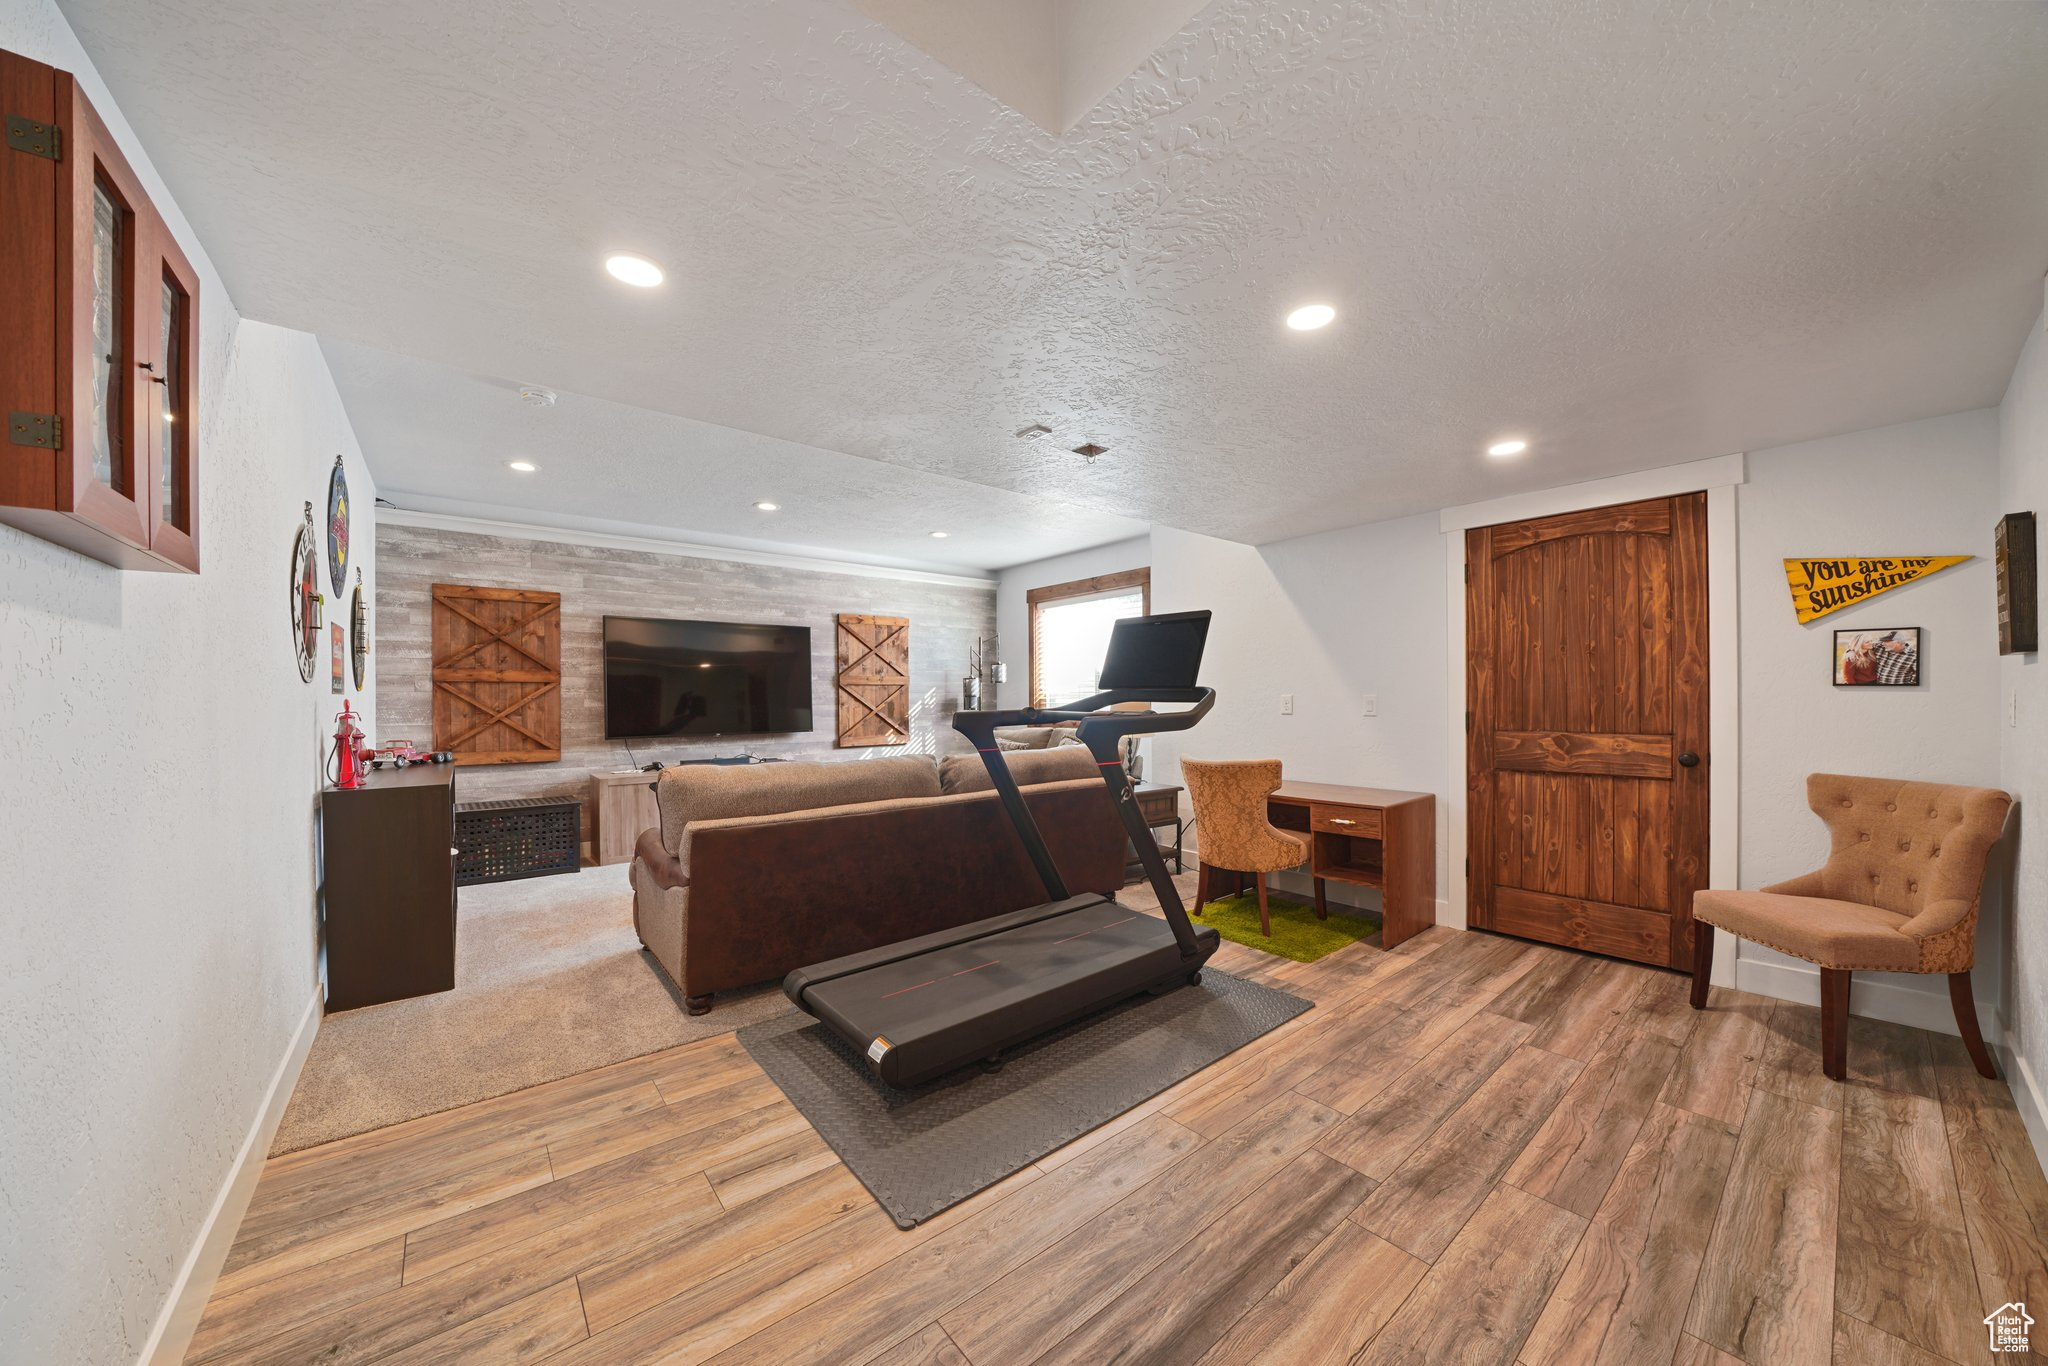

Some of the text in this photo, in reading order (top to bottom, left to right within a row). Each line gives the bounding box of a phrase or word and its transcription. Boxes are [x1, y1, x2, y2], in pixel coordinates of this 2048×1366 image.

[1859, 559, 1897, 575] are
[1901, 559, 1935, 568] my
[1809, 570, 1922, 613] sunshine
